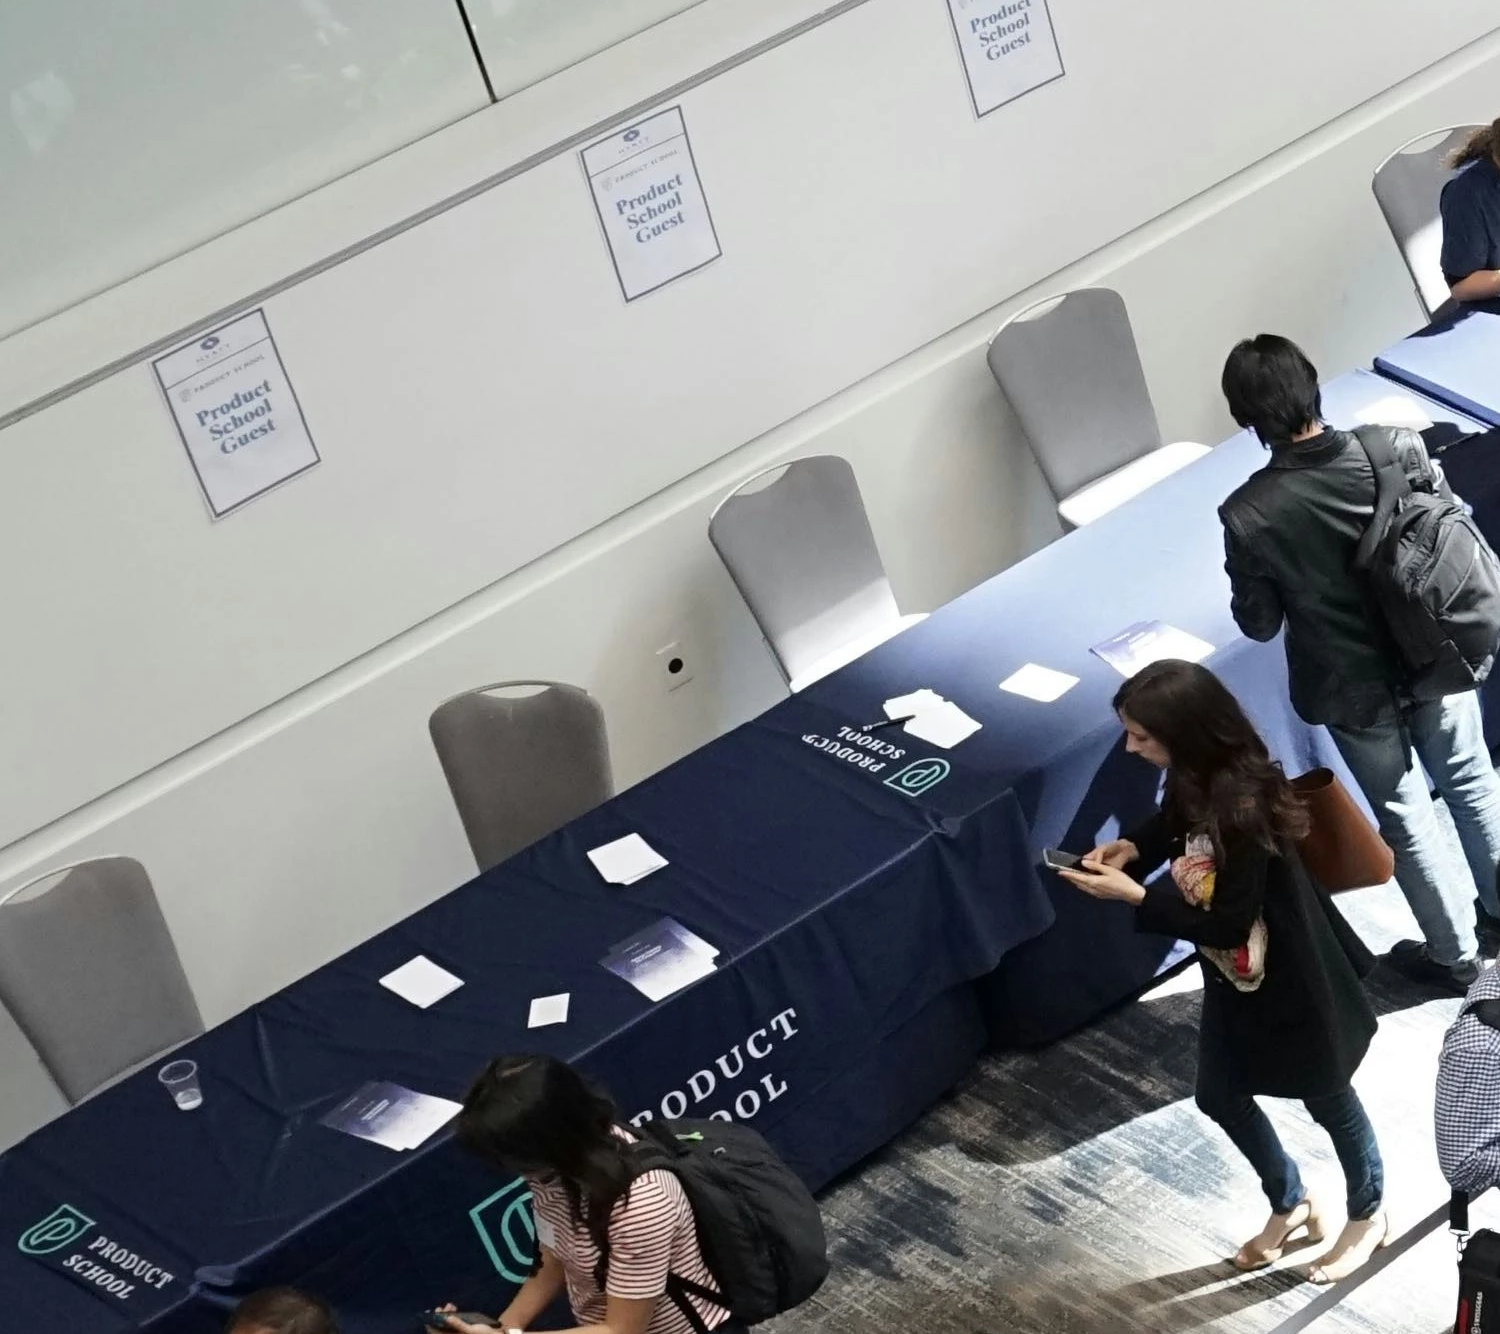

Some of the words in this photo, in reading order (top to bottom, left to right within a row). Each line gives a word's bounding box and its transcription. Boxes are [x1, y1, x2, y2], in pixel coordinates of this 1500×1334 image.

[979, 12, 1030, 48] School
[986, 31, 1032, 61] Guest
[616, 174, 683, 216] Product
[626, 191, 683, 230] School
[635, 210, 686, 244] Guest
[194, 379, 272, 427] Product
[209, 398, 273, 442] School
[219, 418, 276, 455] Guest
[802, 734, 886, 774] PRODUCT
[839, 725, 906, 759] SCHOOL
[630, 1007, 800, 1128] RODUCT
[62, 1254, 137, 1300] SCHOOL
[88, 1235, 176, 1290] PRODUCT
